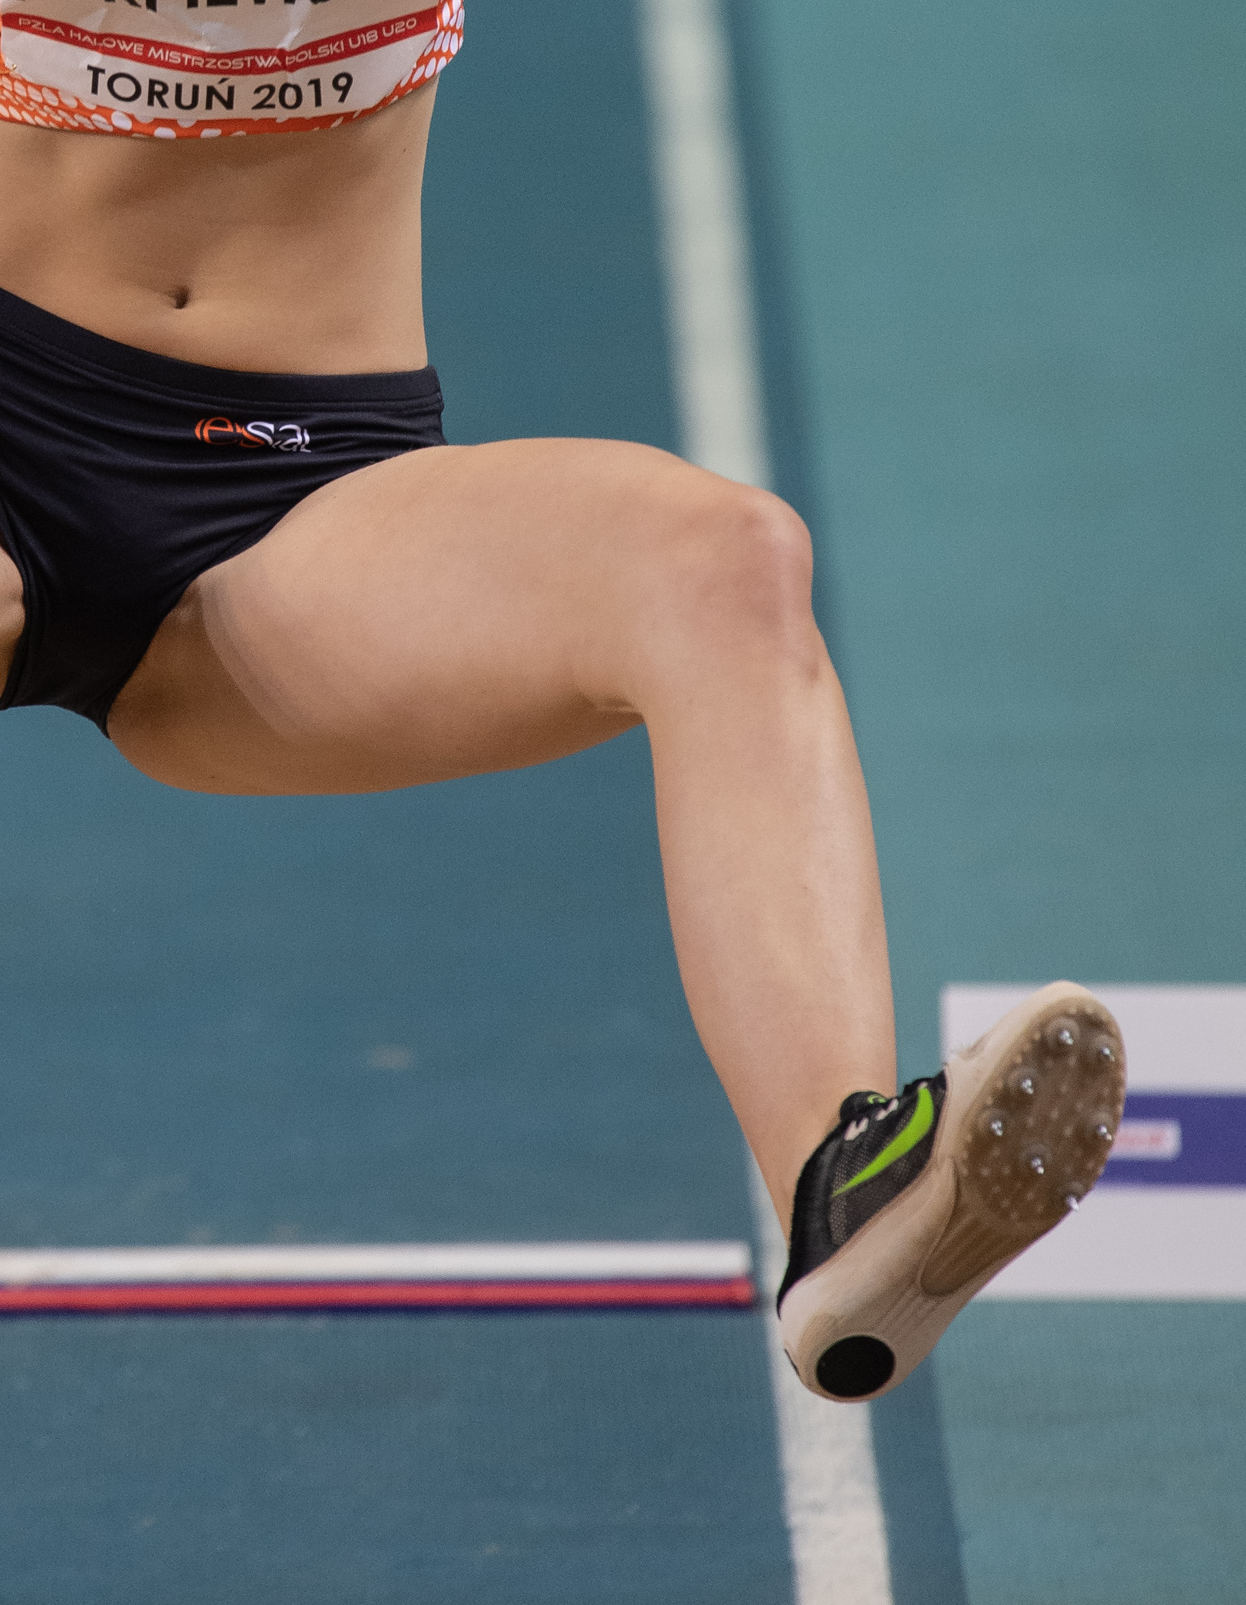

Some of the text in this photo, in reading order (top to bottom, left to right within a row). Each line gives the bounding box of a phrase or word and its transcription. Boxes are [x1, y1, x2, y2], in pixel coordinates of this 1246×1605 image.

[18, 16, 417, 70] PZLA HALOWE MISTRZOSTWA POLSKI U18 U20
[87, 64, 354, 111] TORUŃ 2019
